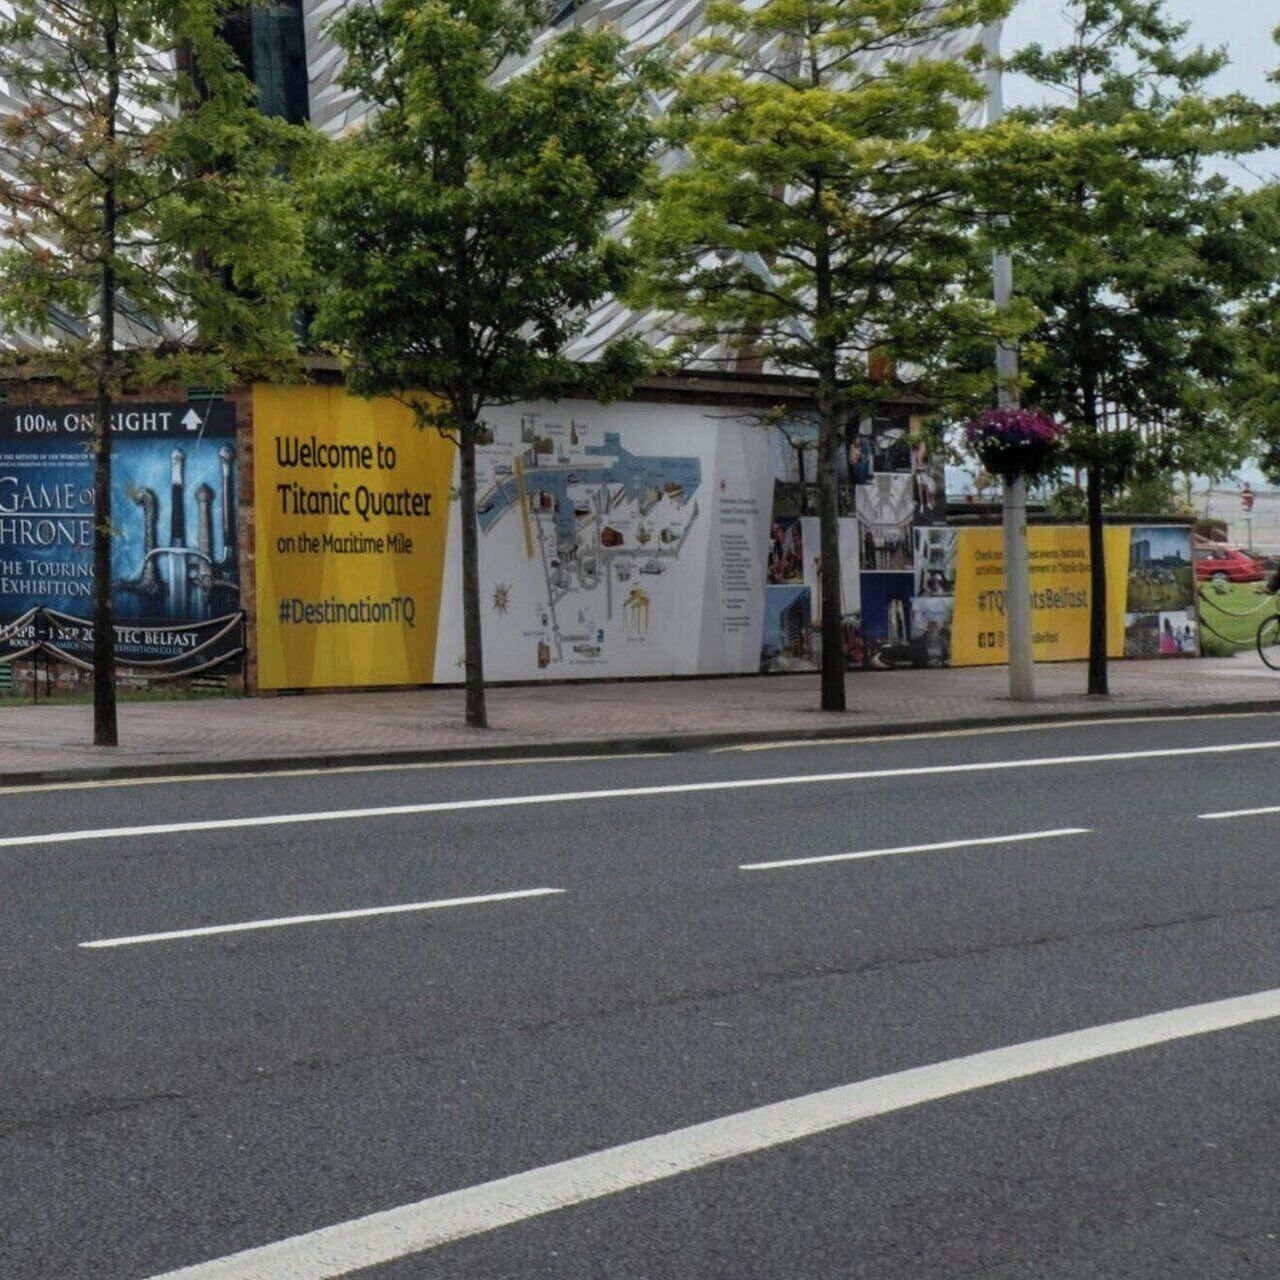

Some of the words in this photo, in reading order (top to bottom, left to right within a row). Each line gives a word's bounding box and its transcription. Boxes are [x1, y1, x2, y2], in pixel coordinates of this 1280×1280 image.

[64, 413, 95, 431] ON
[275, 436, 372, 469] Welcome
[377, 442, 396, 470] to
[277, 482, 350, 516] Titanic
[355, 485, 432, 522] Quarter
[277, 537, 295, 554] on
[298, 532, 319, 554] the
[322, 533, 384, 554] Maritime
[387, 533, 413, 554] Mile
[1, 577, 92, 596] EXHIBITION
[279, 596, 416, 628] #DestinationTQ
[978, 587, 1088, 616] #TQtsBelfast
[58, 627, 79, 640] SEP
[144, 631, 198, 646] BELFAST
